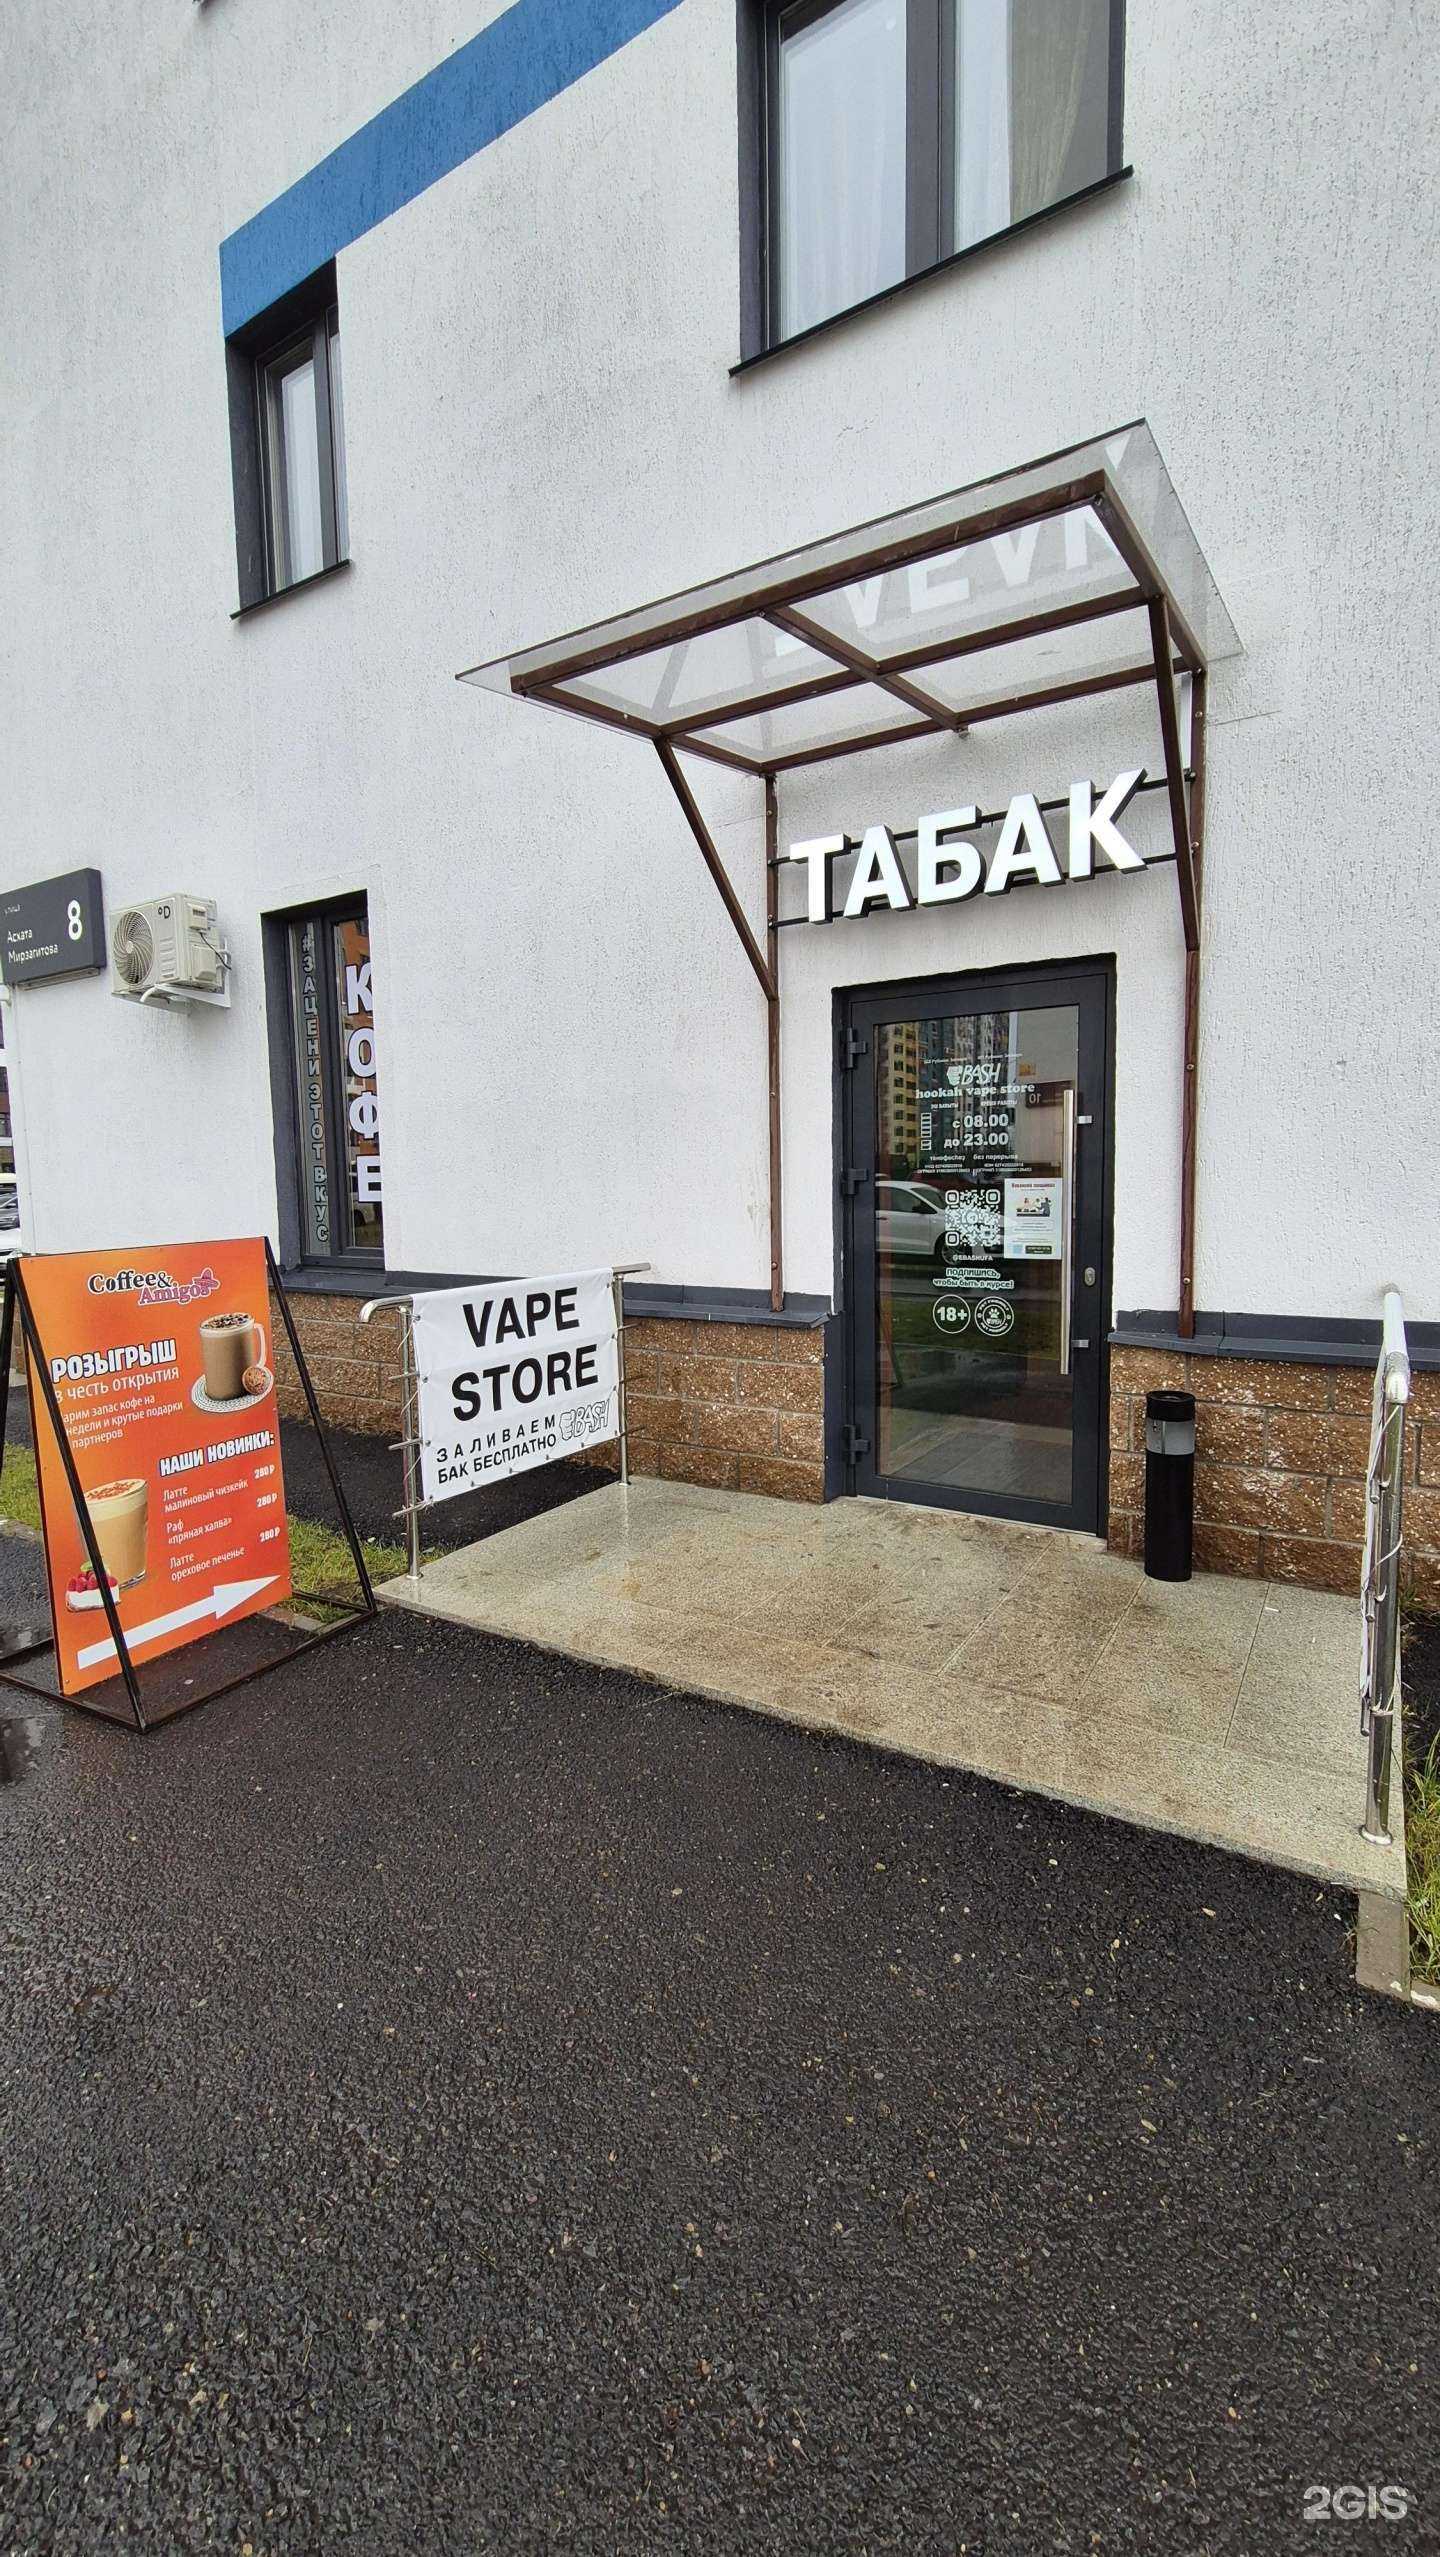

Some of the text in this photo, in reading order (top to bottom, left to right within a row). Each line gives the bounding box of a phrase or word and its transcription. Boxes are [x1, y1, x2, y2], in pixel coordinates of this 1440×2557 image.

[789, 767, 1147, 924] ТАБАК
[67, 900, 83, 940] 8
[7, 929, 33, 943] Асхата
[8, 944, 58, 964] Мирзагитова
[302, 936, 329, 1242] #ЗАЦЕНИ ЭТОТ ВКУС
[345, 962, 383, 1202] КОФЕ
[916, 1083, 1035, 1099] hookah vape store
[964, 1114, 1009, 1128] 08.00
[944, 1132, 1009, 1149] до 23.00
[139, 1281, 210, 1304] Amigos
[933, 1278, 958, 1287] чтобы
[959, 1278, 979, 1288] быть
[462, 1287, 580, 1348] VAPE
[937, 1306, 968, 1321] 18+
[51, 1339, 177, 1384] РОЗЫГРЫШ
[67, 1382, 109, 1400] честь
[112, 1367, 179, 1390] открытия
[451, 1344, 599, 1421] STORE
[92, 1403, 118, 1416] запас
[120, 1396, 142, 1411] кофе
[144, 1395, 155, 1404] на
[103, 1419, 110, 1427] и
[112, 1411, 145, 1426] крутые
[146, 1402, 183, 1417] подарки
[72, 1428, 123, 1448] партнеров
[436, 1415, 556, 1463] ЗАЛИВАЕМ
[160, 1431, 275, 1476] НАШИ НОВИНКИ:
[438, 1433, 557, 1484] БАК БЕСПЛАТНО
[163, 1486, 188, 1502] Латте
[165, 1479, 249, 1513] малиновый чизкейк
[166, 1518, 183, 1533] Раф
[168, 1517, 232, 1545] «пряная халва»
[170, 1553, 194, 1570] Латте
[171, 1547, 245, 1582] ореховое печенье
